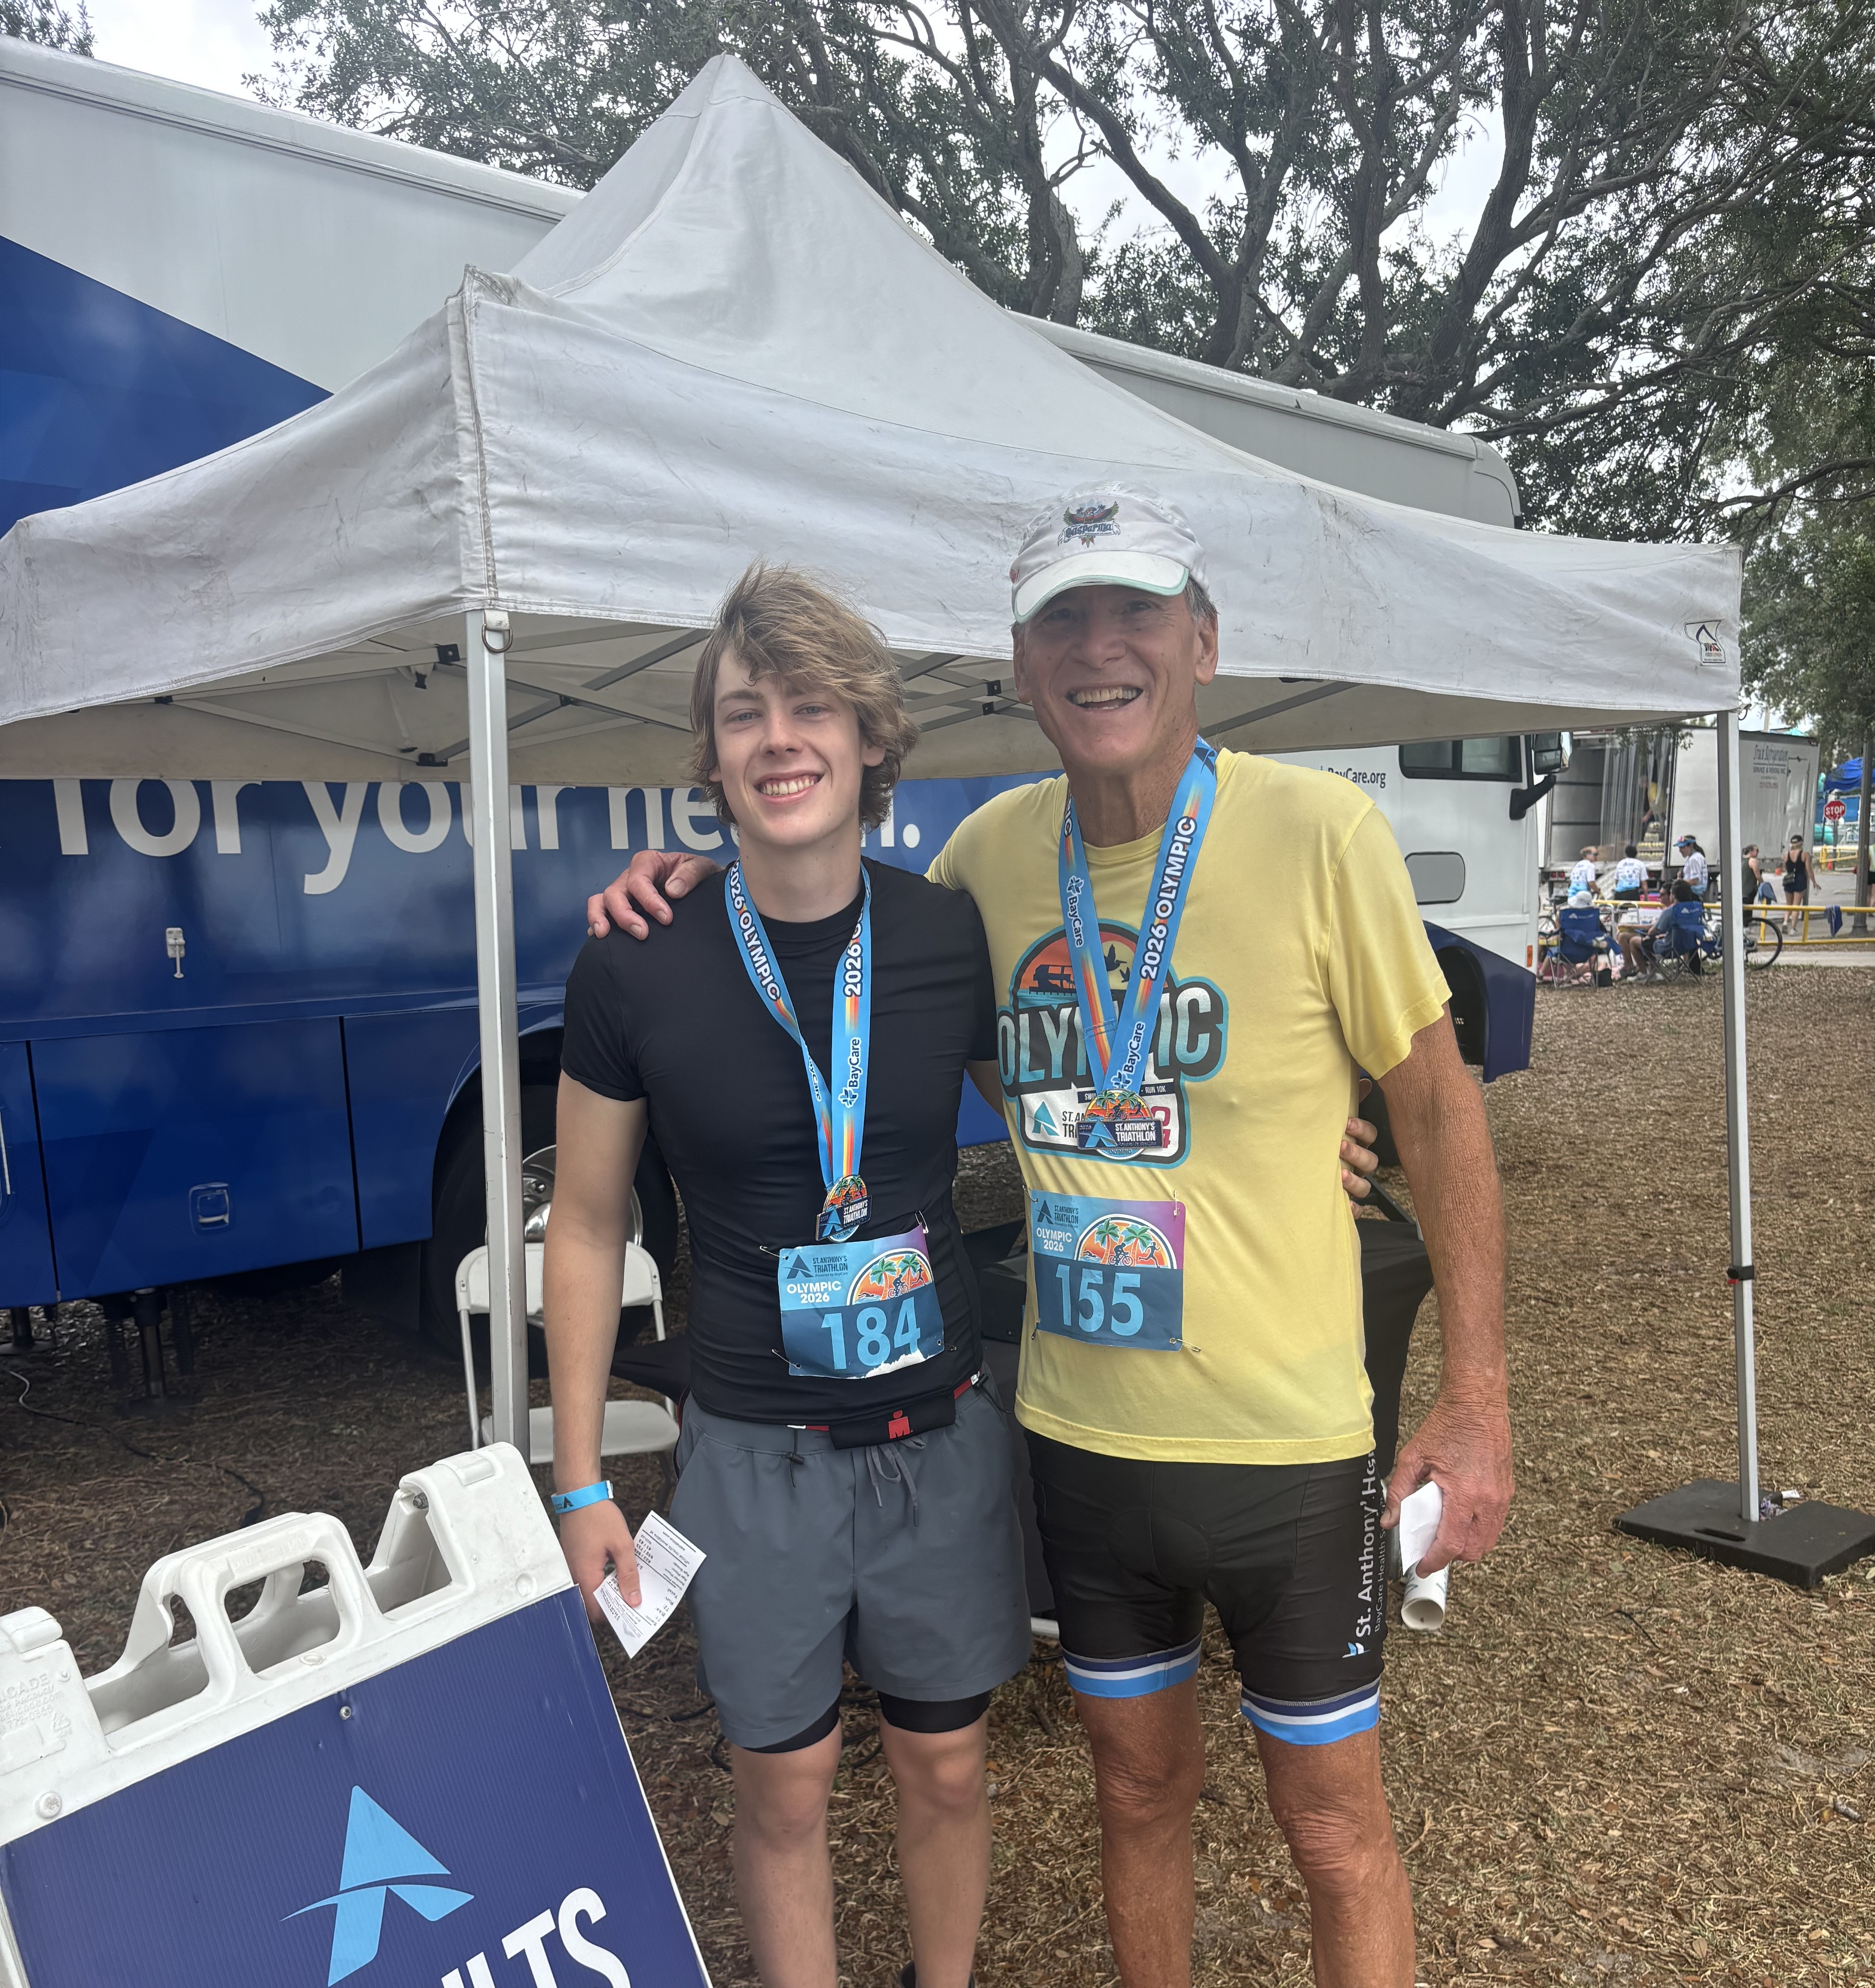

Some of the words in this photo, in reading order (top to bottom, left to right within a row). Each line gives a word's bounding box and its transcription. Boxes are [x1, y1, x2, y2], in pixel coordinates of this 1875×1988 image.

[1328, 767, 1386, 788] Care.org
[1826, 806, 1845, 815] STOP
[1069, 896, 1083, 946] BayCare
[1141, 924, 1167, 980] 2026
[1156, 818, 1195, 918] OLYMPIC
[730, 862, 744, 909] 2026
[740, 912, 780, 999] OLYMPIC
[845, 943, 862, 996] 2026
[998, 987, 1211, 1086] OLYIC
[1123, 1023, 1144, 1073] BayCare
[809, 1056, 821, 1100] ayCare
[848, 1038, 863, 1087] BayCare
[1116, 1132, 1155, 1141] TRIATHLON
[843, 1207, 867, 1224] TRIATHLON
[1036, 1228, 1072, 1242] OLYMPIC
[1043, 1239, 1064, 1252] 2026
[787, 1281, 842, 1294] OLYMPIC
[813, 1263, 848, 1273] TRIATHLON
[800, 1292, 830, 1304] 2026
[1055, 1264, 1144, 1336] 155
[821, 1296, 920, 1370] 184
[1356, 1607, 1371, 1637] St.
[1375, 1584, 1384, 1632] BayCare
